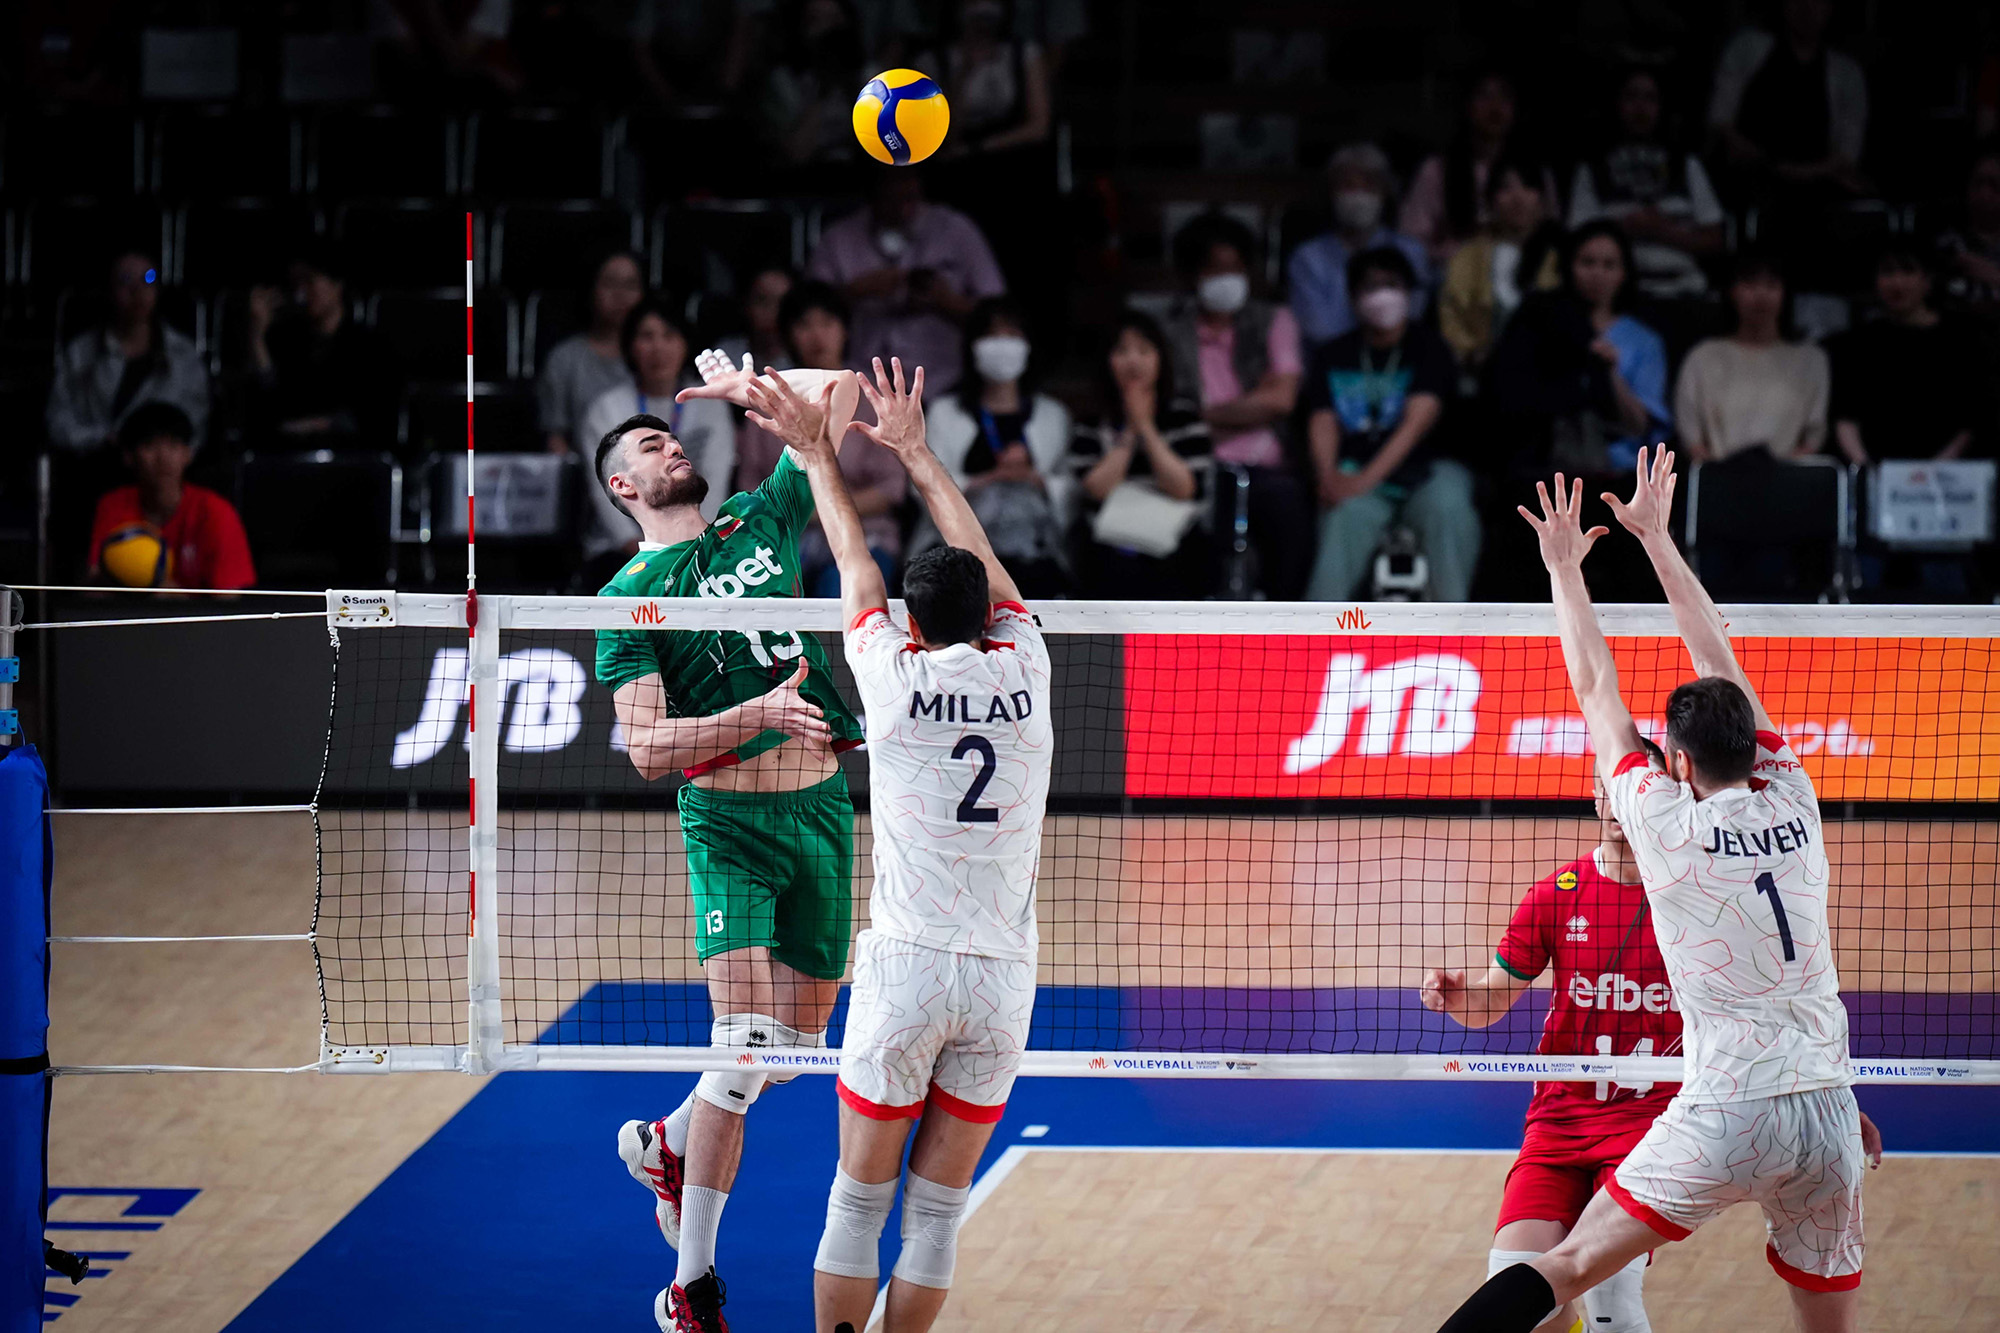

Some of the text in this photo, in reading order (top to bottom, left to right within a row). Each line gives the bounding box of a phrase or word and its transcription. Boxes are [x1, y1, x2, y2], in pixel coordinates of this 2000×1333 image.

[352, 596, 386, 605] Senoh
[631, 601, 666, 624] VNL
[1336, 607, 1372, 629] VNL
[908, 689, 1033, 723] MILAD
[1283, 652, 1483, 775] JTB
[950, 734, 999, 823] 2
[1704, 816, 1809, 857] JELVEH
[705, 909, 725, 936] 13
[1754, 871, 1796, 962] 1
[736, 1052, 841, 1066] VNL VOLLEYBALL
[1088, 1056, 1194, 1070] VNL VOLLEYBALL
[1443, 1060, 1549, 1073] VNL VOLLEYBALL
[1853, 1066, 1908, 1076] LEYBALL
